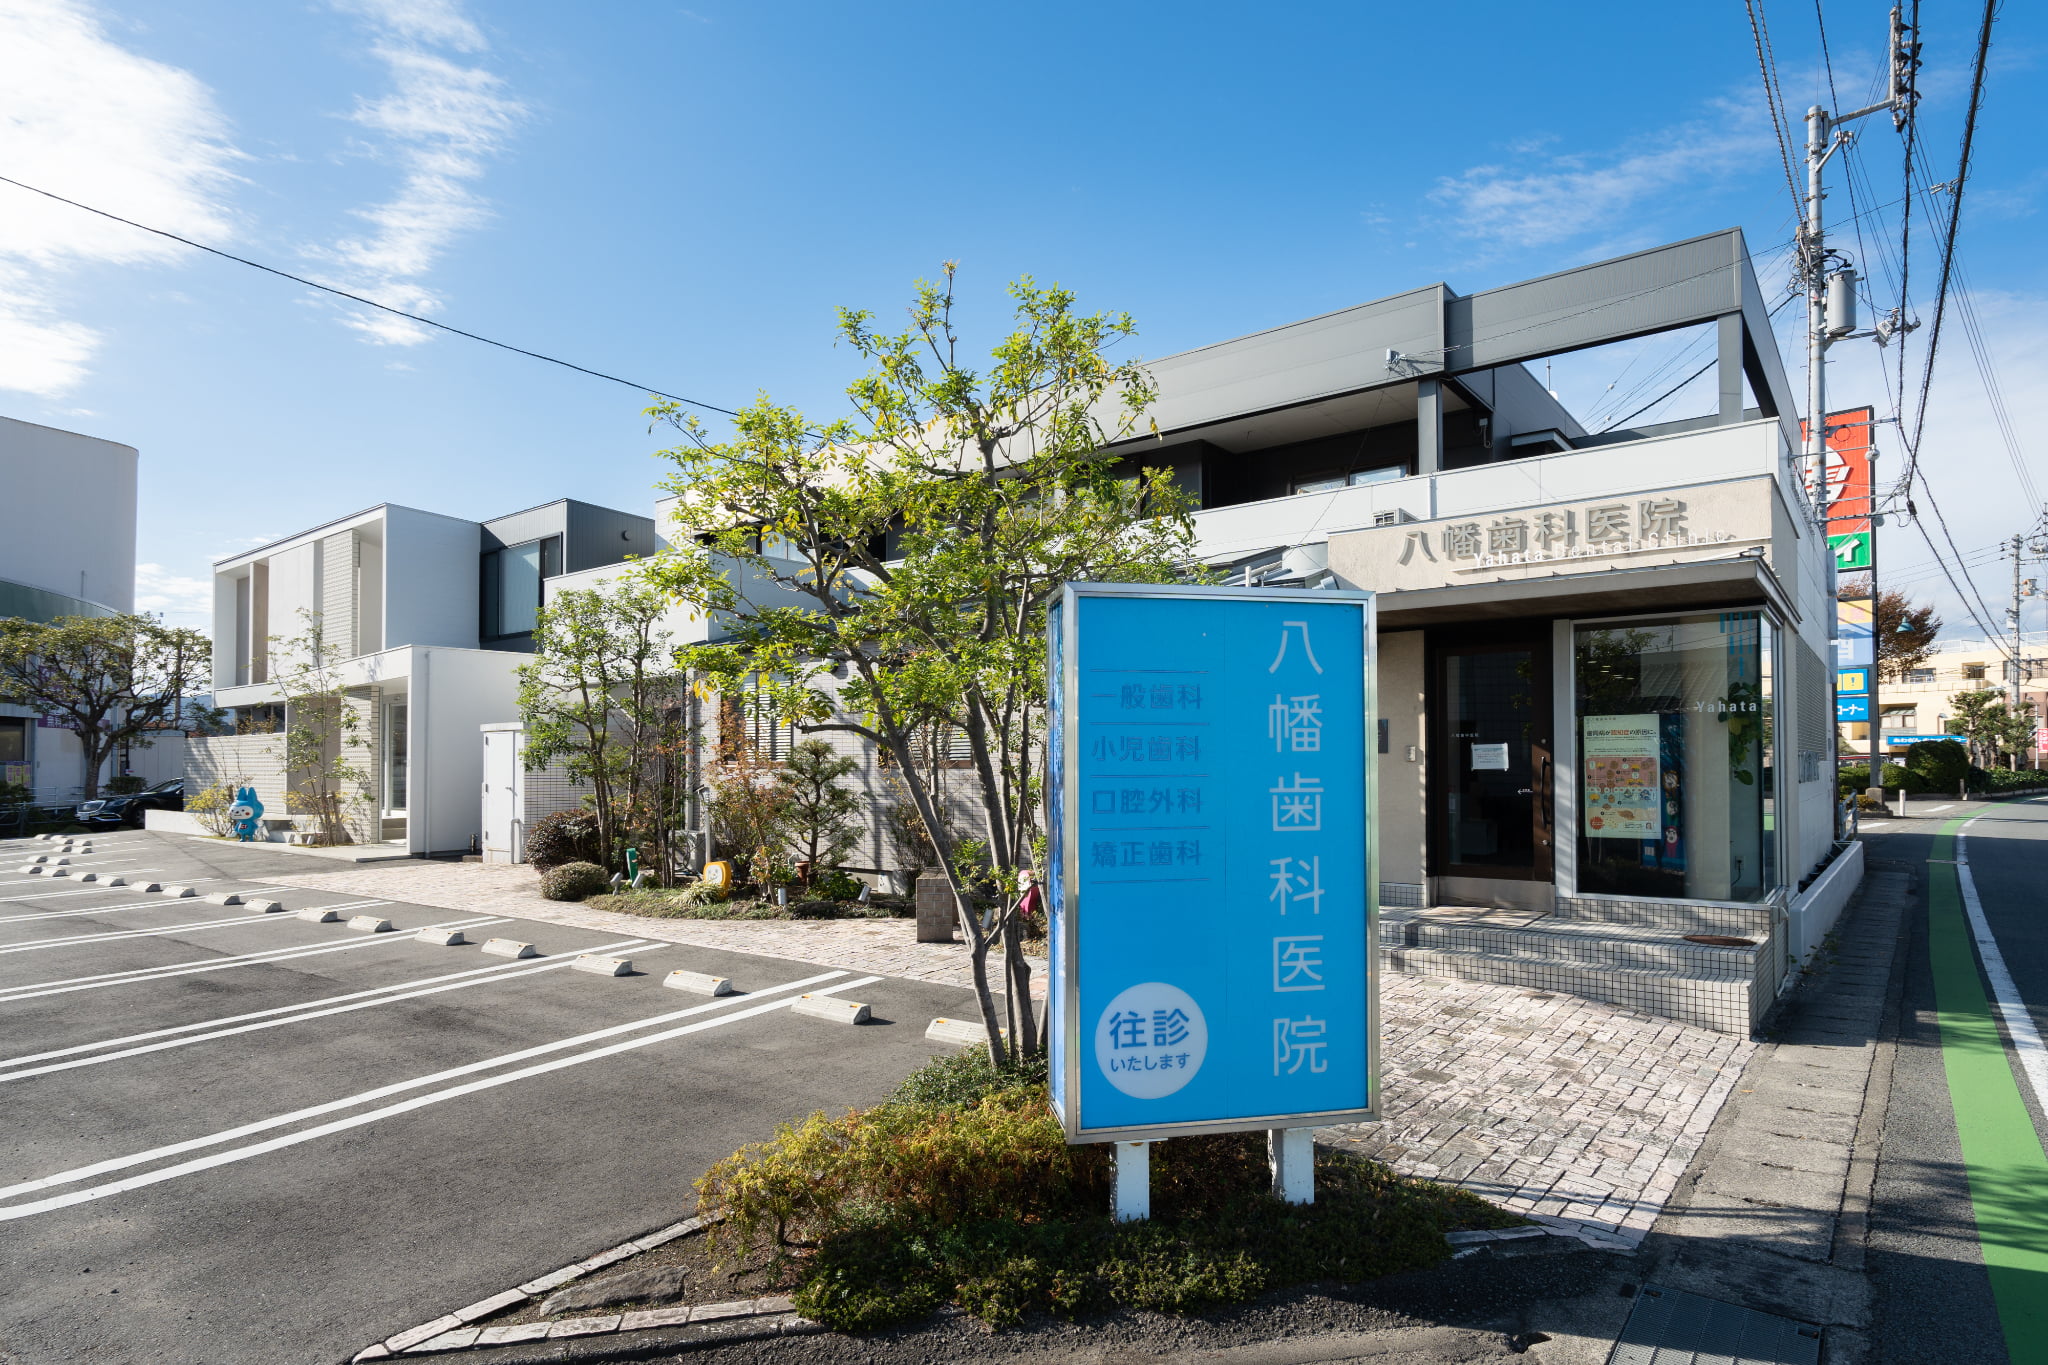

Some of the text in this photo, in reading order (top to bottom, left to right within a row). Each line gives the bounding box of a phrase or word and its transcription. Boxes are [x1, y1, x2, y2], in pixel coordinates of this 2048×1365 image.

[1399, 498, 1684, 566] 八幡歯科医院
[1473, 549, 1544, 568] Yahata
[1554, 534, 1632, 560] Dental
[1089, 683, 1203, 709] 一般歯科
[1696, 701, 1757, 713] Yahata
[1090, 735, 1203, 761] 小児歯科
[1091, 786, 1203, 815] 口腔外科
[1090, 839, 1203, 868] 矯正歯科
[1268, 620, 1328, 1076] 八幡歯科医院
[1109, 1008, 1190, 1050] 往診
[1110, 1052, 1191, 1072] いたします
